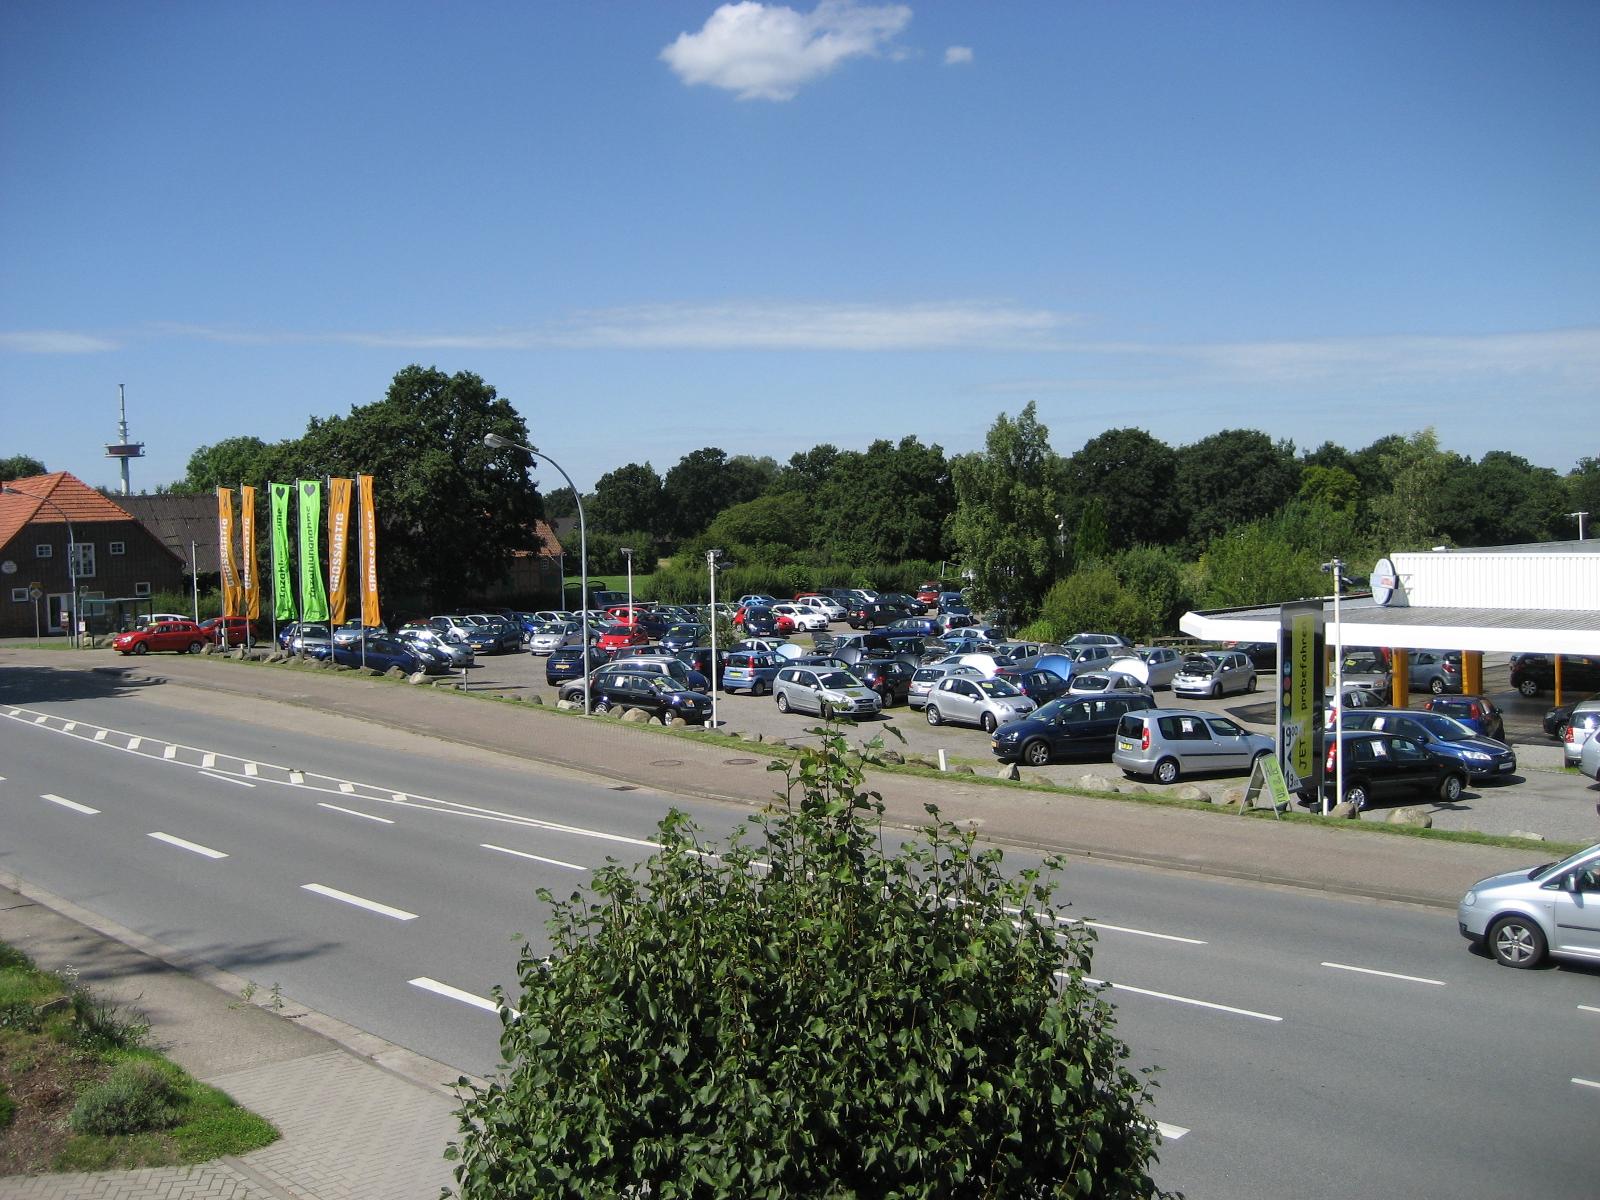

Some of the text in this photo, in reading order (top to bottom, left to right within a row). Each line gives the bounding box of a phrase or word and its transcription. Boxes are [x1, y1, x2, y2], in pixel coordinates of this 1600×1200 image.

[277, 507, 285, 598] Inzahlme
[331, 512, 344, 593] GROSSARTIG
[368, 511, 376, 592] GROSSARTIG
